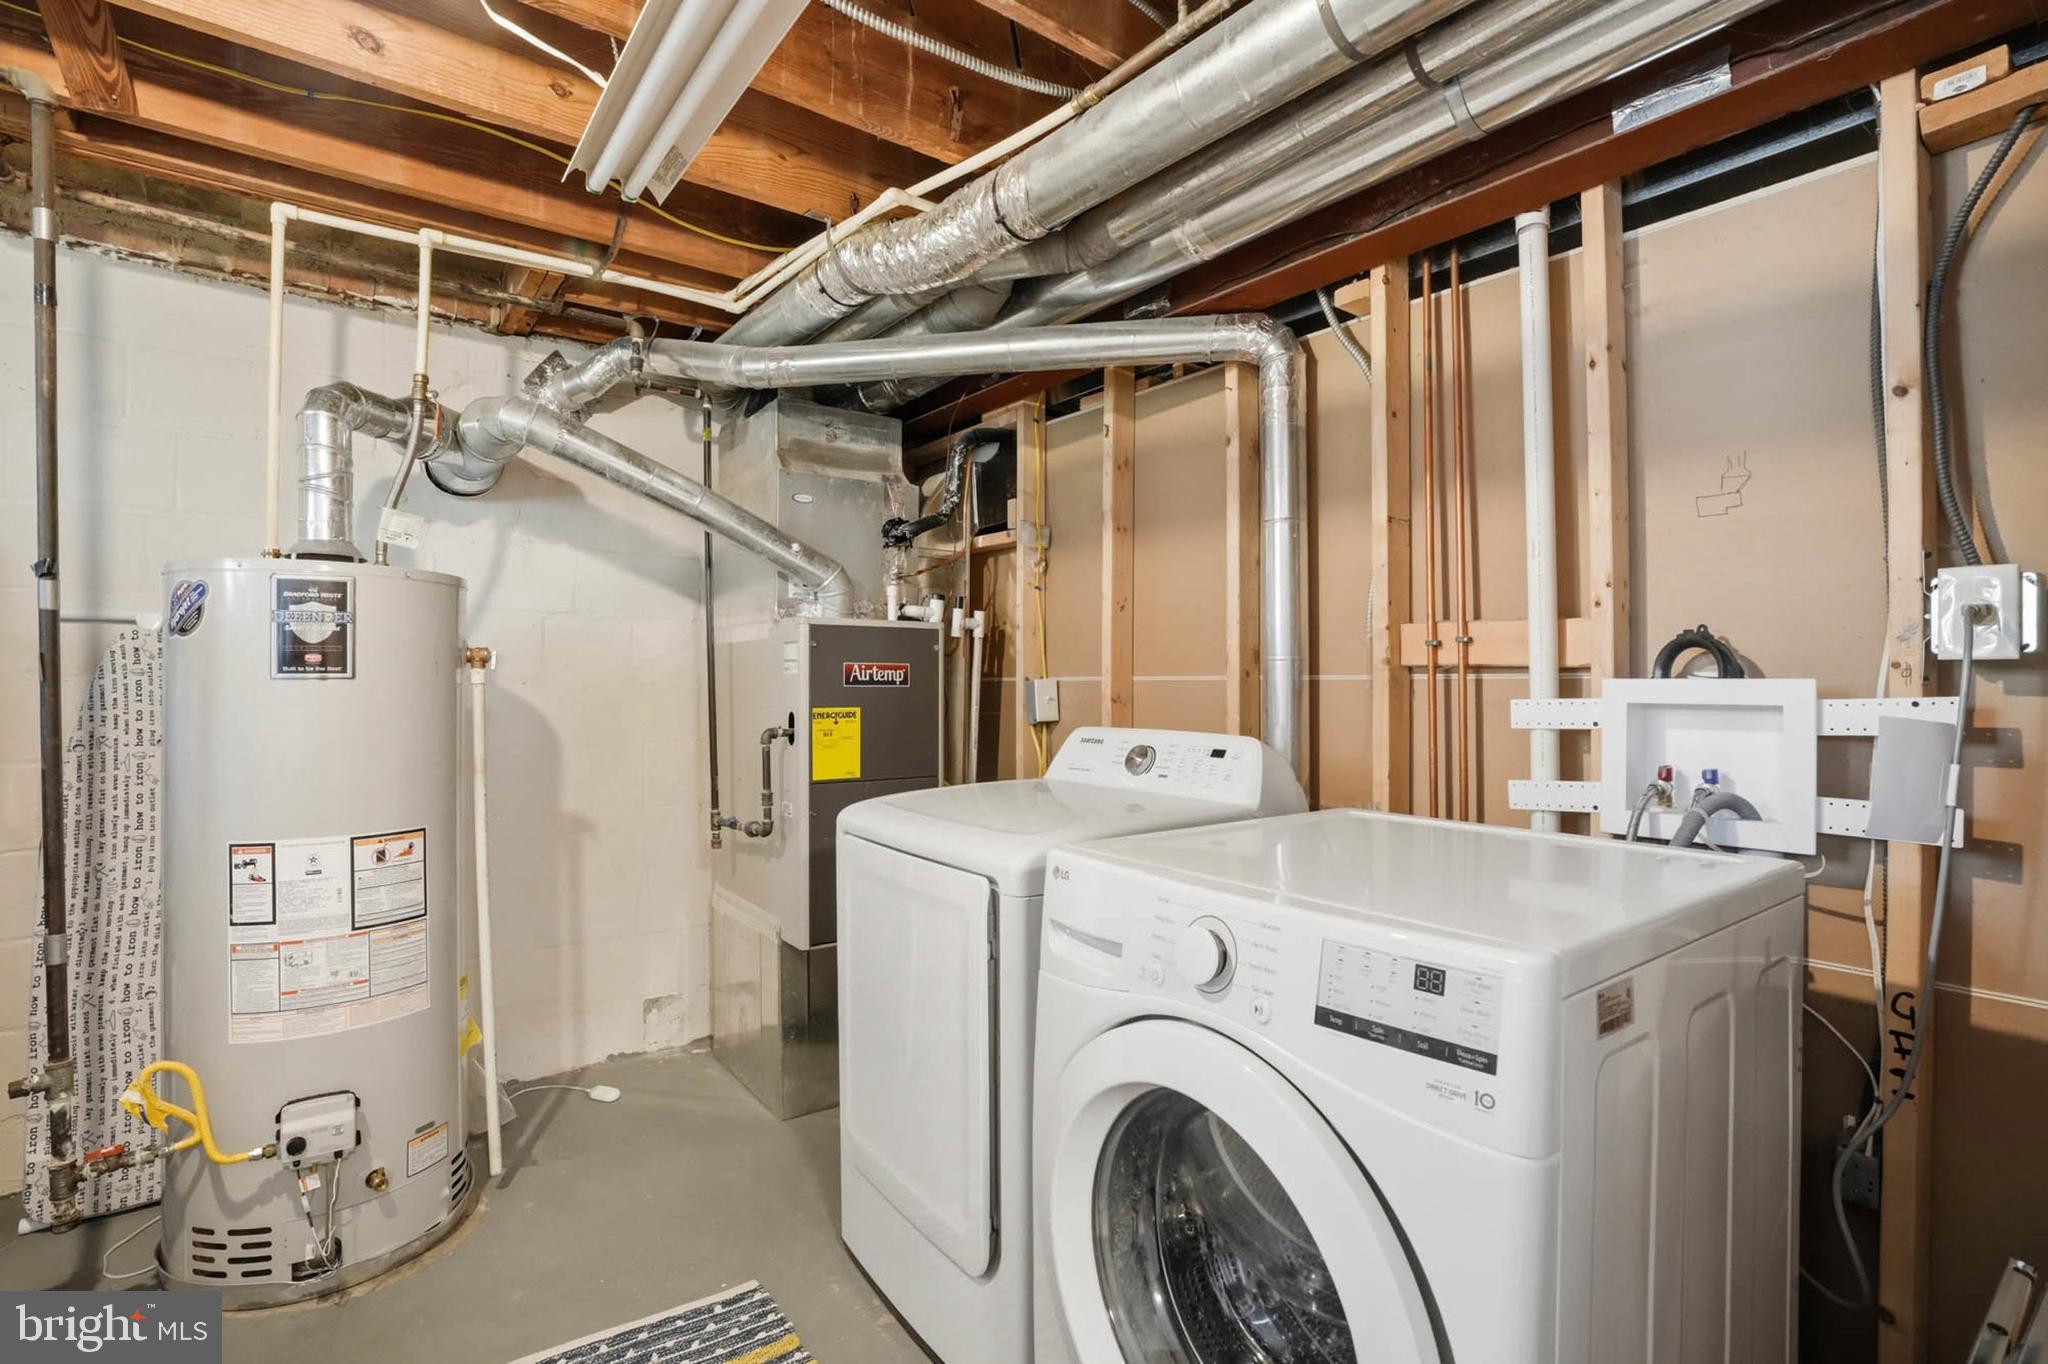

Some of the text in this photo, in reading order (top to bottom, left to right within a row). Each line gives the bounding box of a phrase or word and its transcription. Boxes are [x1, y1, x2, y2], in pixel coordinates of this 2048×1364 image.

[272, 610, 354, 623] DEFENDER
[131, 630, 139, 640] to
[131, 647, 141, 665] how
[849, 664, 905, 685] Airtemp
[134, 679, 143, 703] iron
[135, 709, 143, 721] to
[134, 728, 143, 746] how
[134, 762, 143, 786] iron
[135, 792, 143, 804] to
[133, 811, 143, 830] how
[132, 846, 143, 870] iron
[131, 877, 141, 889] to
[1060, 869, 1070, 881] LG
[128, 896, 139, 915] how
[125, 931, 137, 956] iron
[32, 942, 45, 967] iron
[123, 964, 132, 976] to
[31, 976, 41, 988] to
[120, 983, 131, 1003] how
[29, 996, 38, 1015] how
[121, 1018, 131, 1044] iron
[29, 1033, 38, 1059] iron
[122, 1051, 132, 1064] to
[27, 1126, 38, 1154] iron
[26, 1162, 35, 1175] to
[119, 1167, 129, 1181] ho
